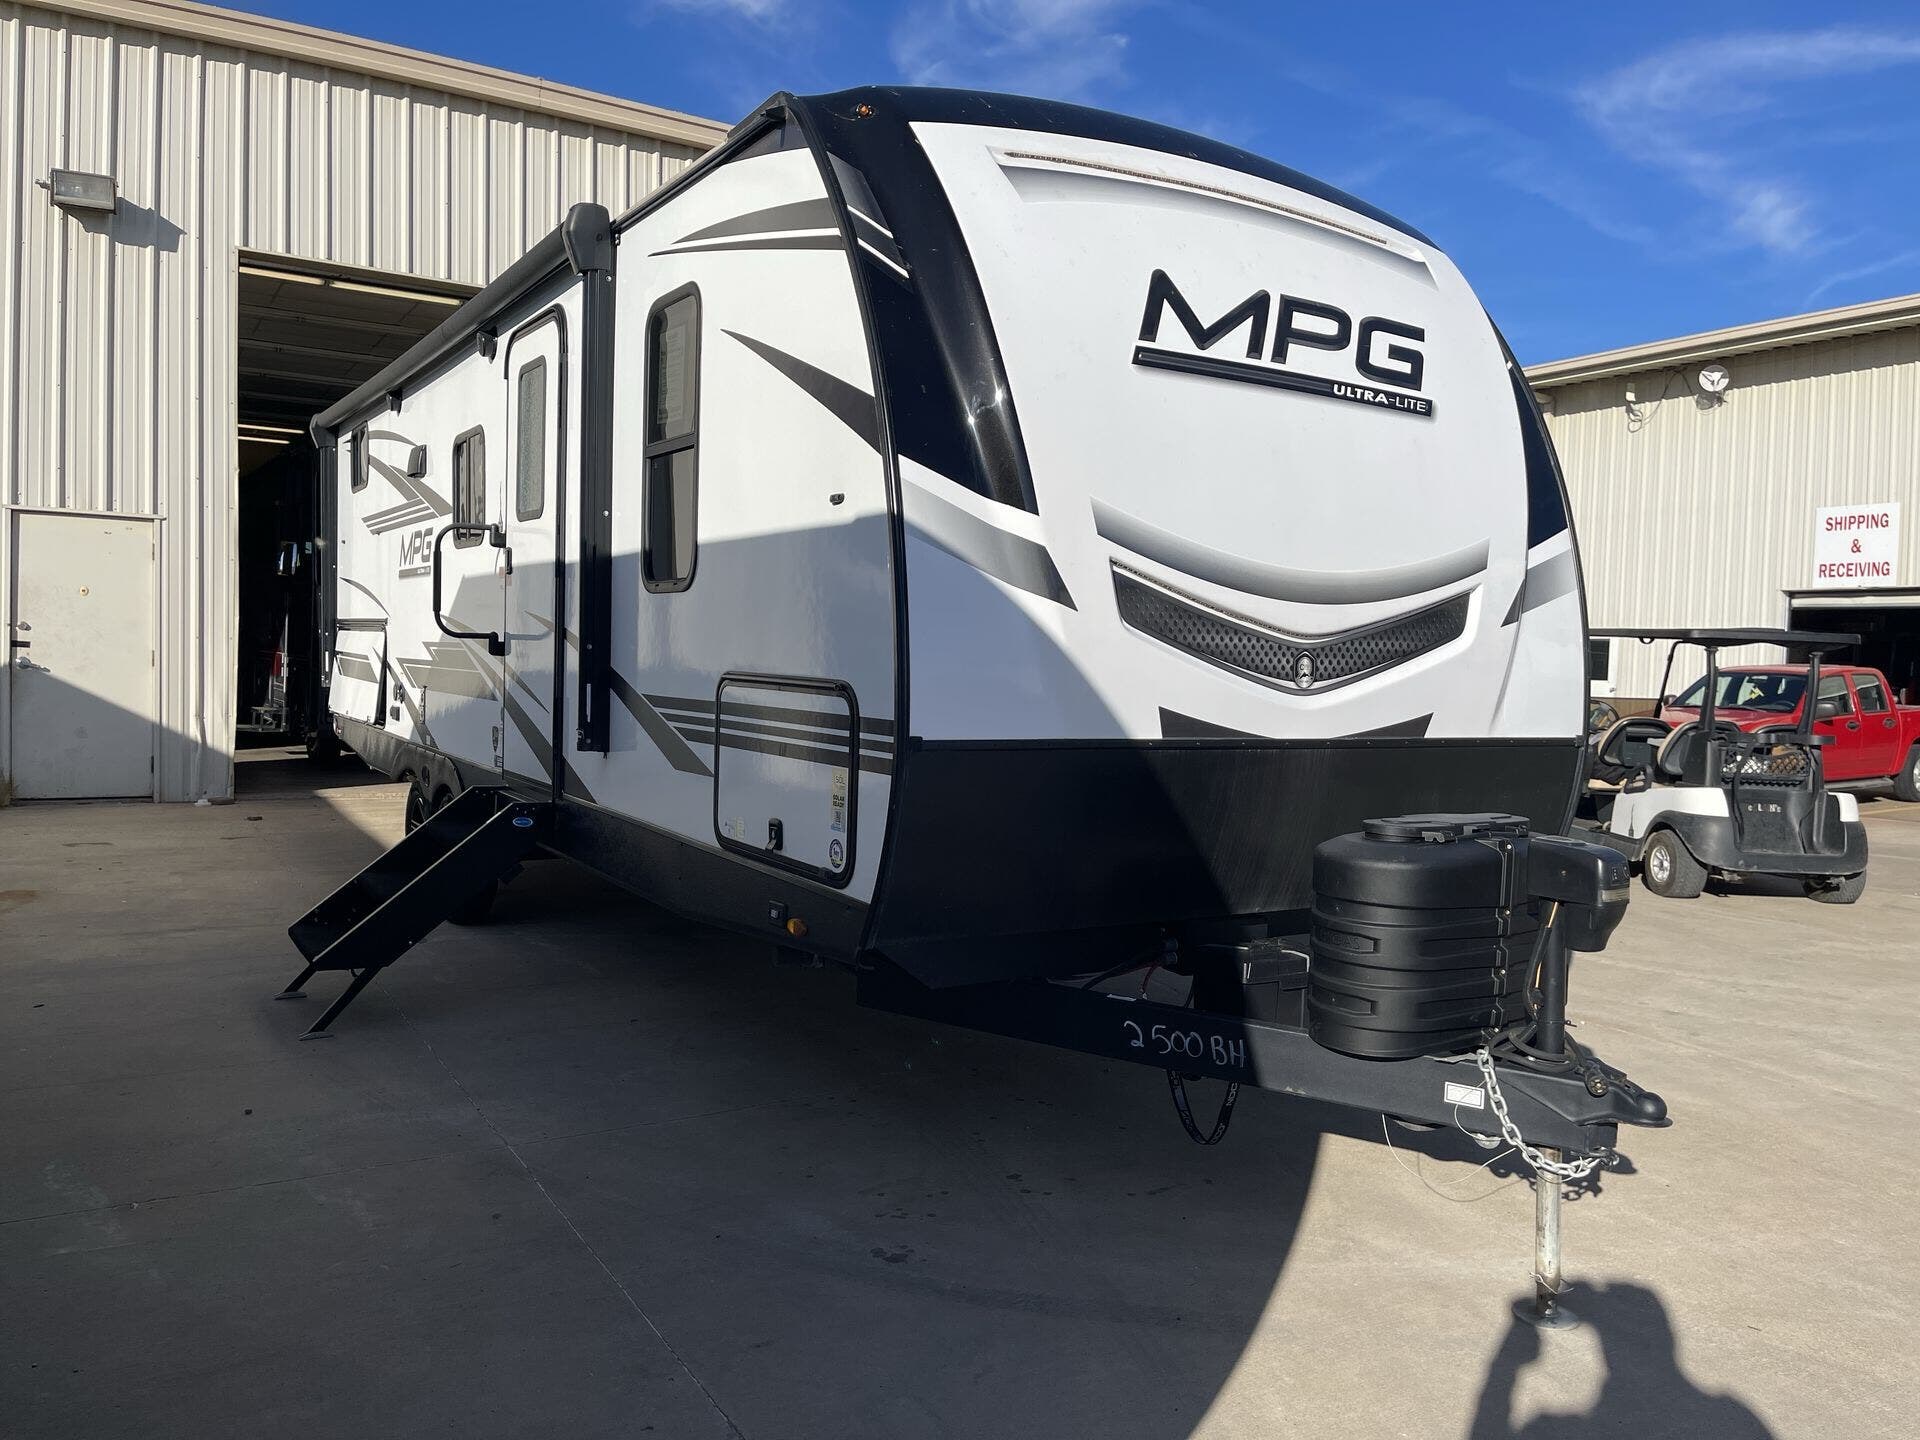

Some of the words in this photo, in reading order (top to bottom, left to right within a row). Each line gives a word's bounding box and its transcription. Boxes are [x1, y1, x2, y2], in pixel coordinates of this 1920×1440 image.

[1138, 268, 1425, 391] MPG
[1333, 383, 1427, 412] ULTRA-LITE
[1825, 512, 1889, 531] SHIPPING
[399, 527, 433, 567] MPG
[1850, 538, 1862, 553] &
[1818, 561, 1890, 578] RECEIVING
[1210, 1035, 1246, 1068] BH
